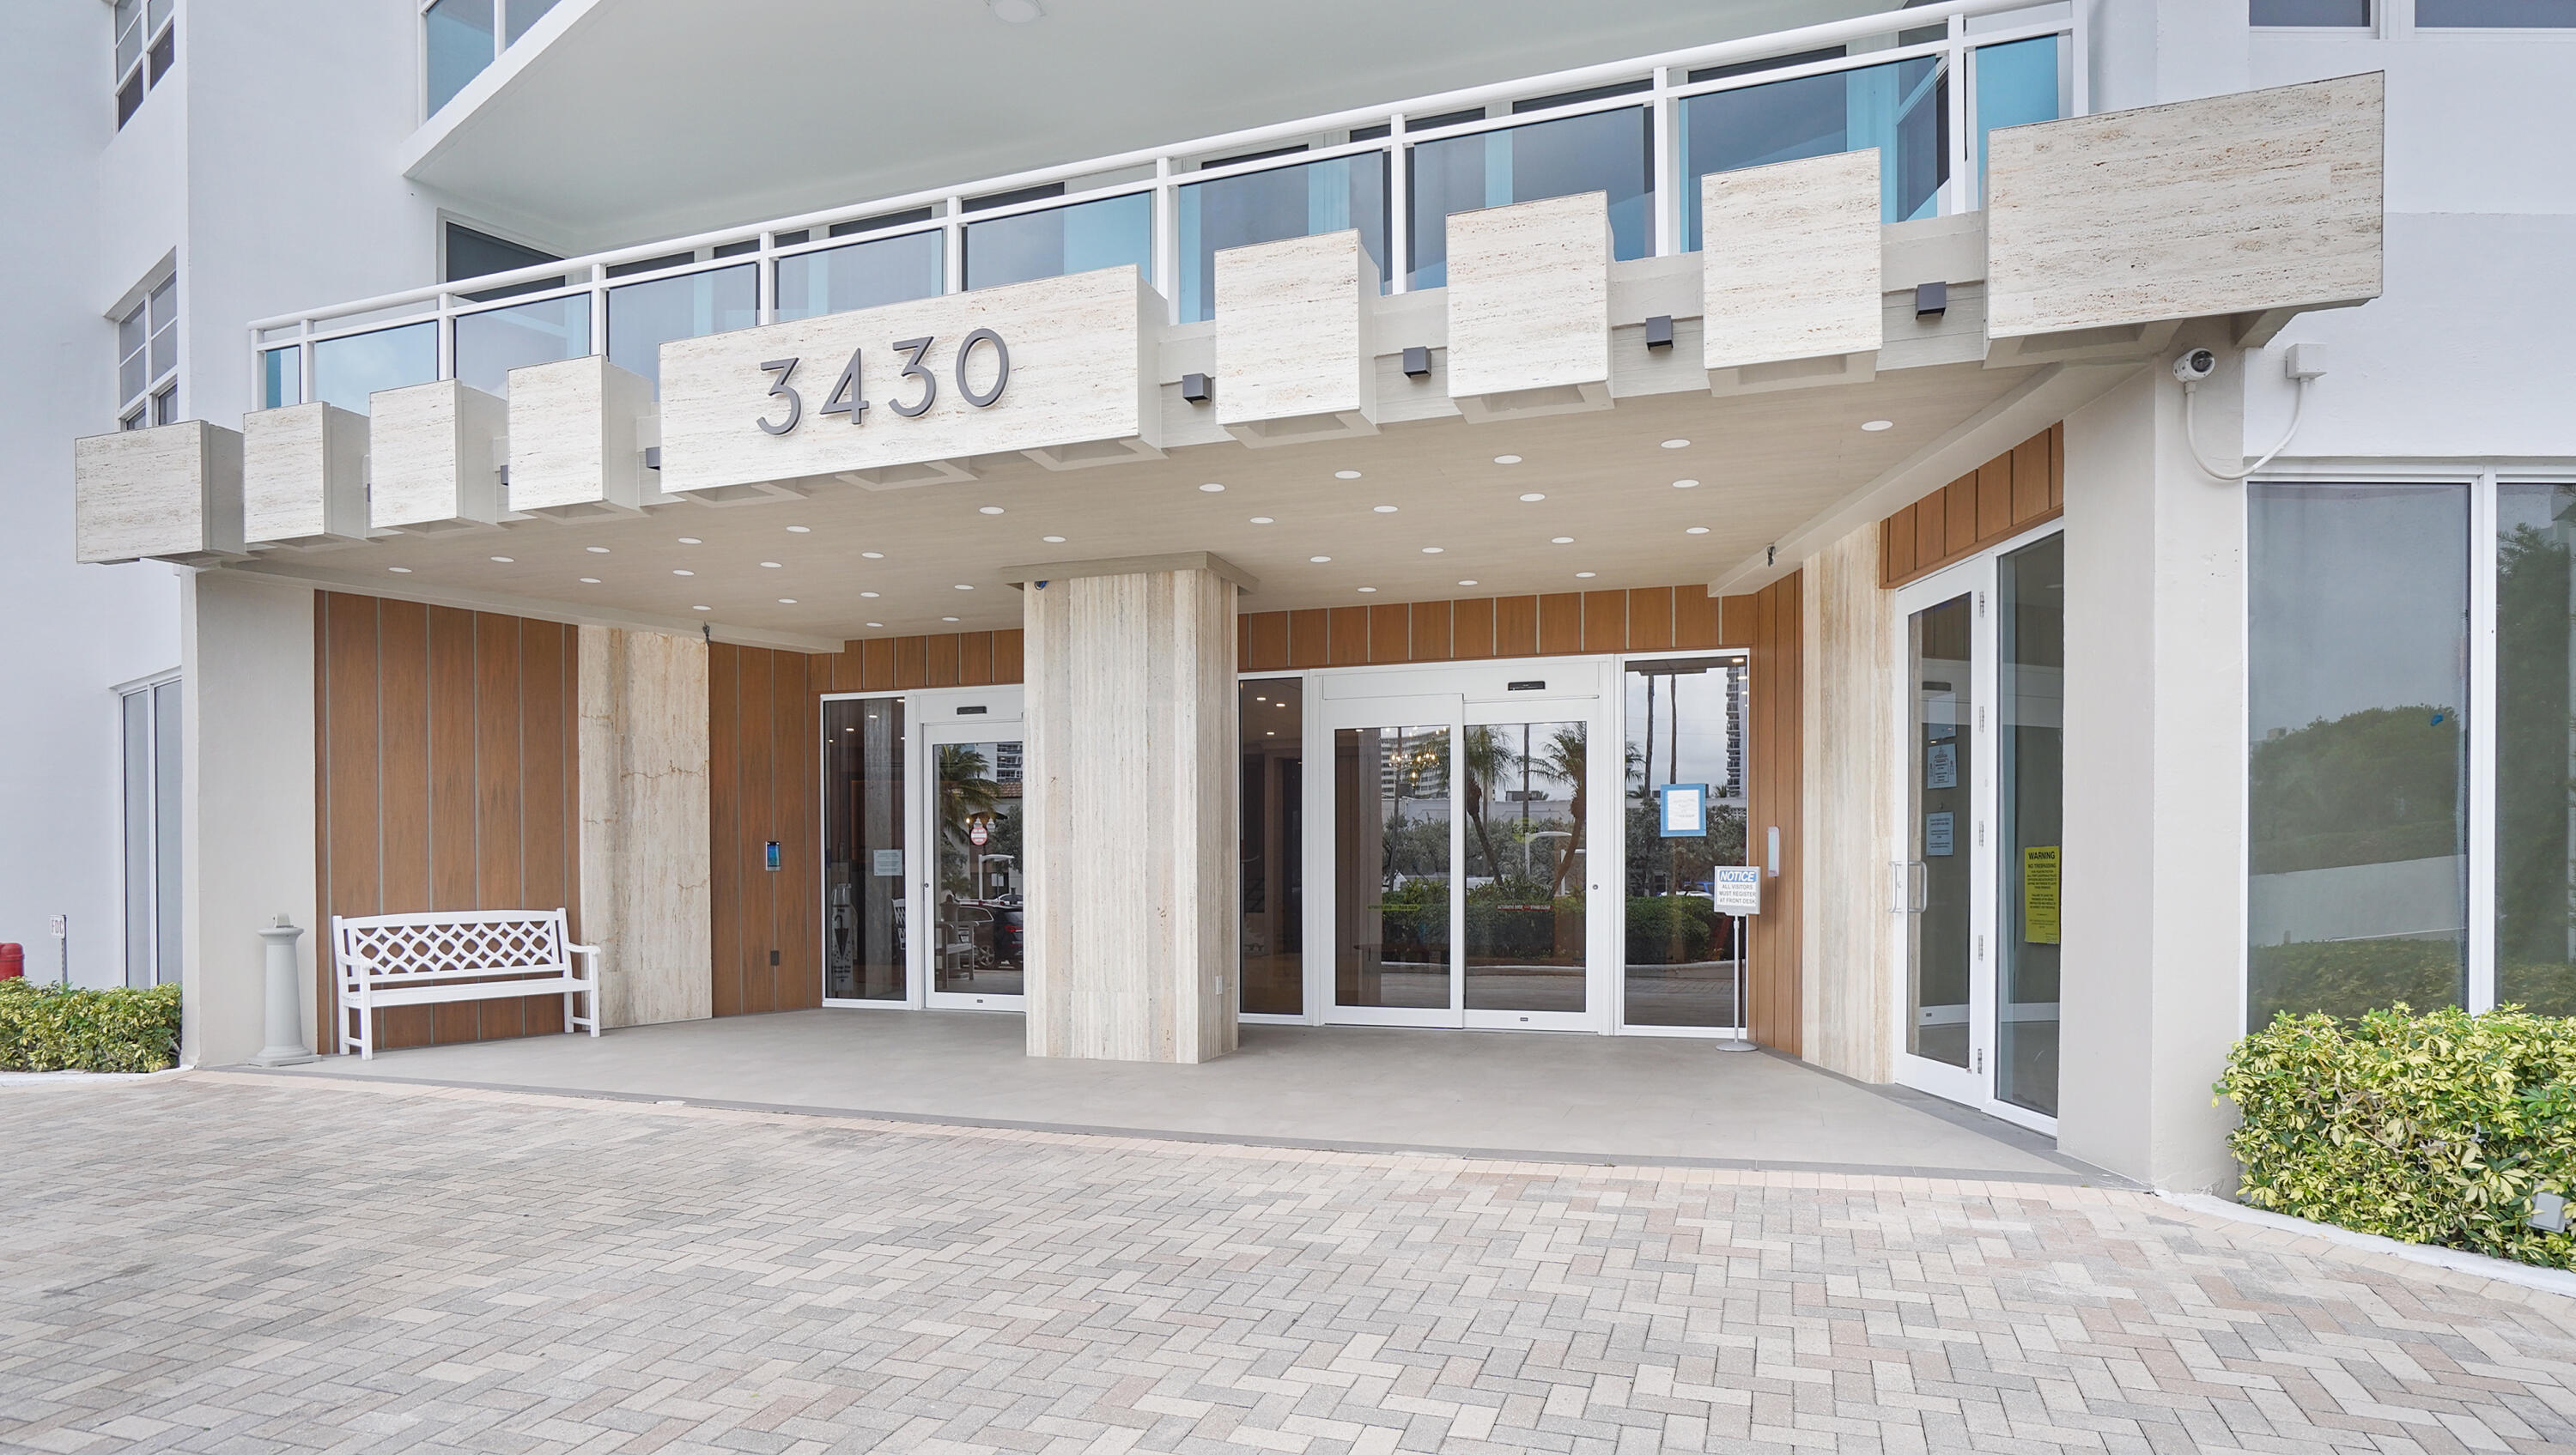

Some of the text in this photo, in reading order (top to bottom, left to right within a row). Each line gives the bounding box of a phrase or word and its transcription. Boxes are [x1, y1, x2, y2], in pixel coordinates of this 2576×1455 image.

[756, 328, 1010, 435] 3430
[2028, 851, 2056, 859] WARNING
[1720, 871, 1755, 882] NOTICE
[51, 919, 64, 934] FDC
